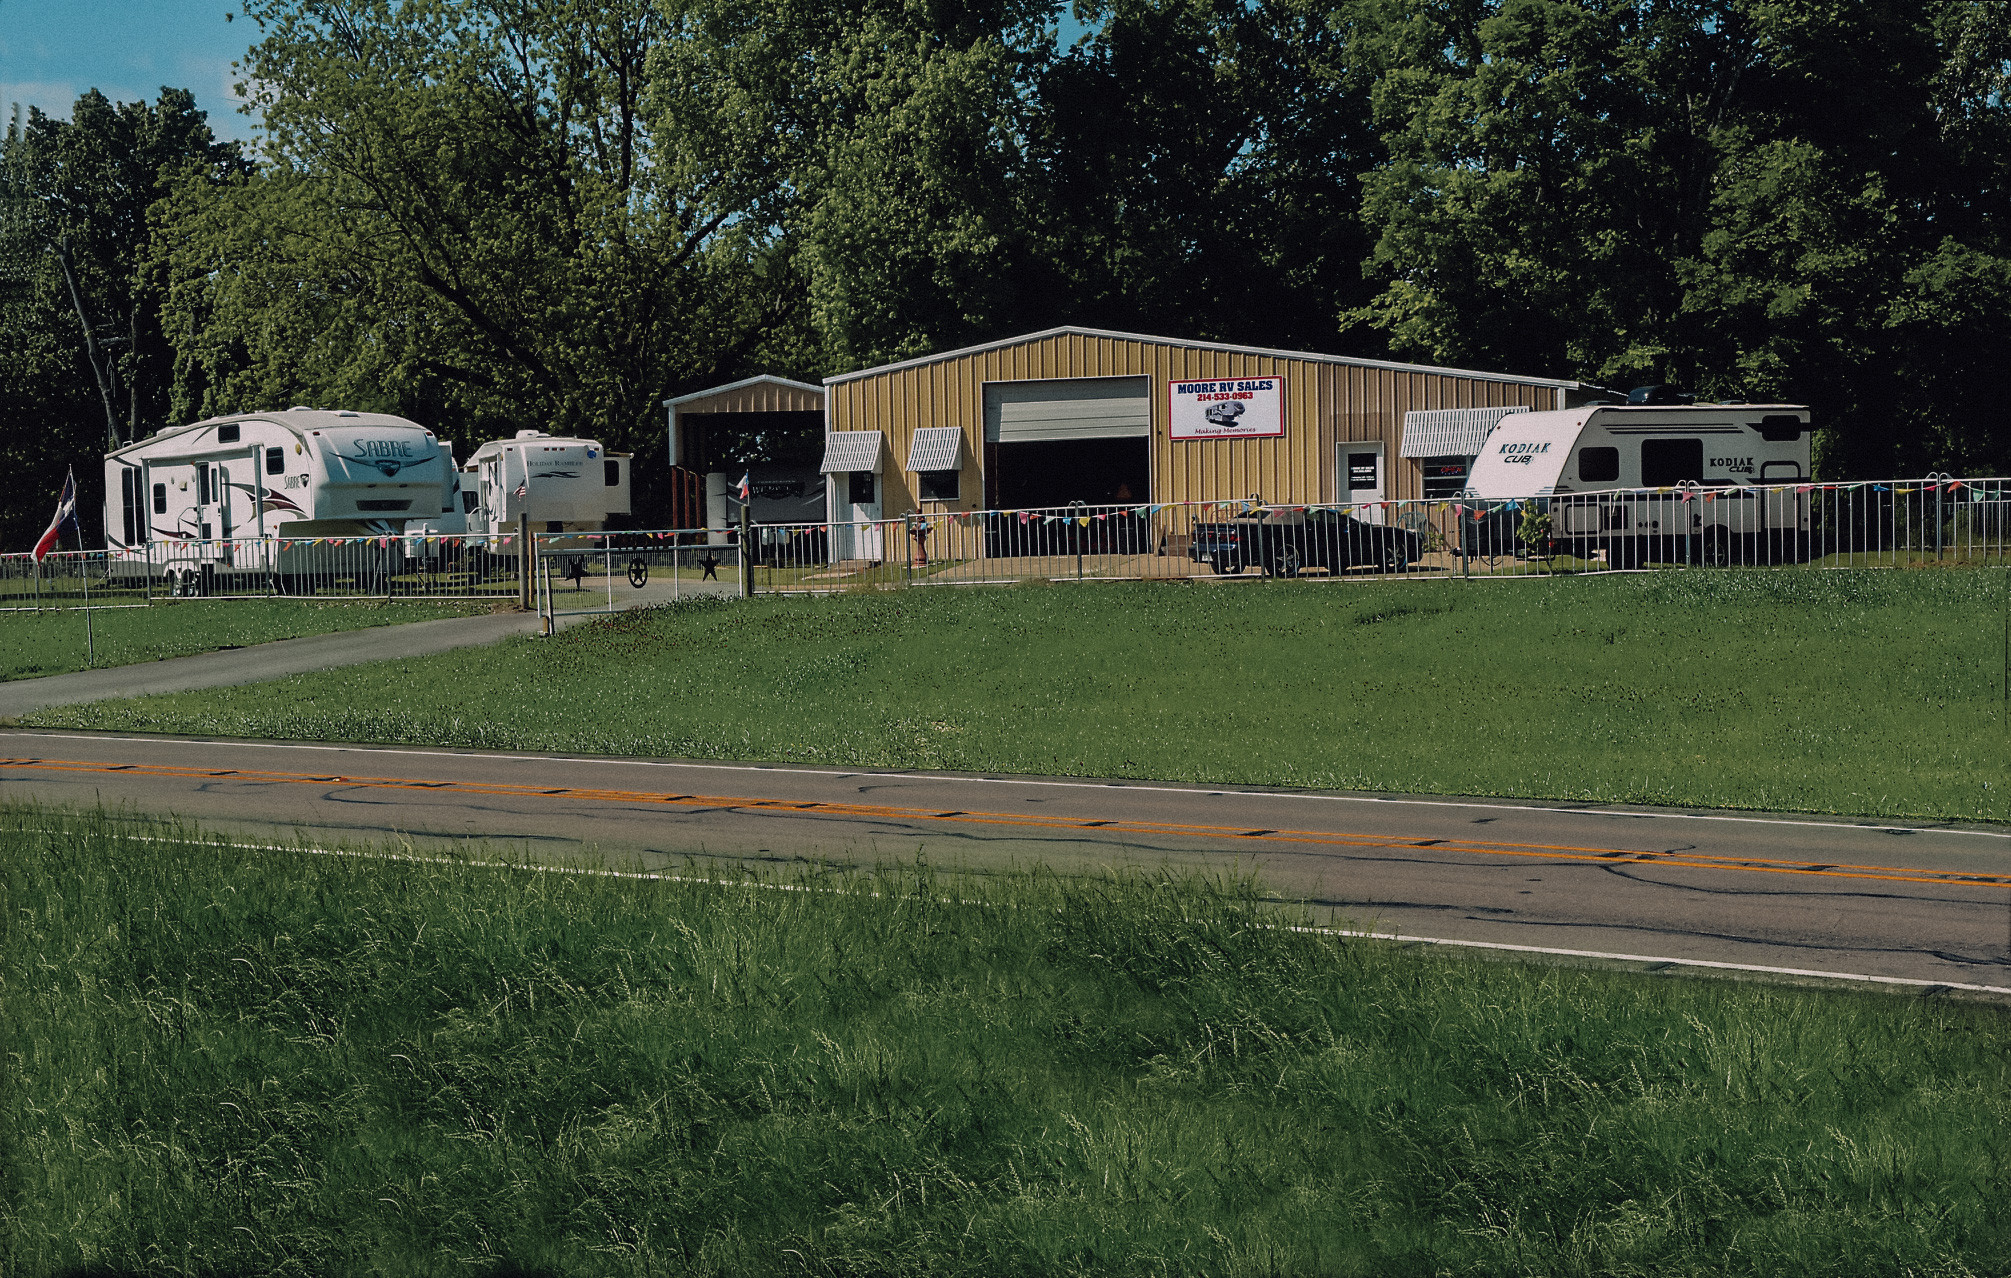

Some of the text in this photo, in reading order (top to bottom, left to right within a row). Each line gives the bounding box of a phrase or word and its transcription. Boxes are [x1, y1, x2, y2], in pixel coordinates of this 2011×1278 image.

[1177, 381, 1273, 393] MOORE RV SALES
[353, 439, 413, 457] SABRE
[1499, 443, 1551, 454] KODIAK
[1504, 455, 1532, 463] CUB
[1710, 457, 1753, 467] KODIAK
